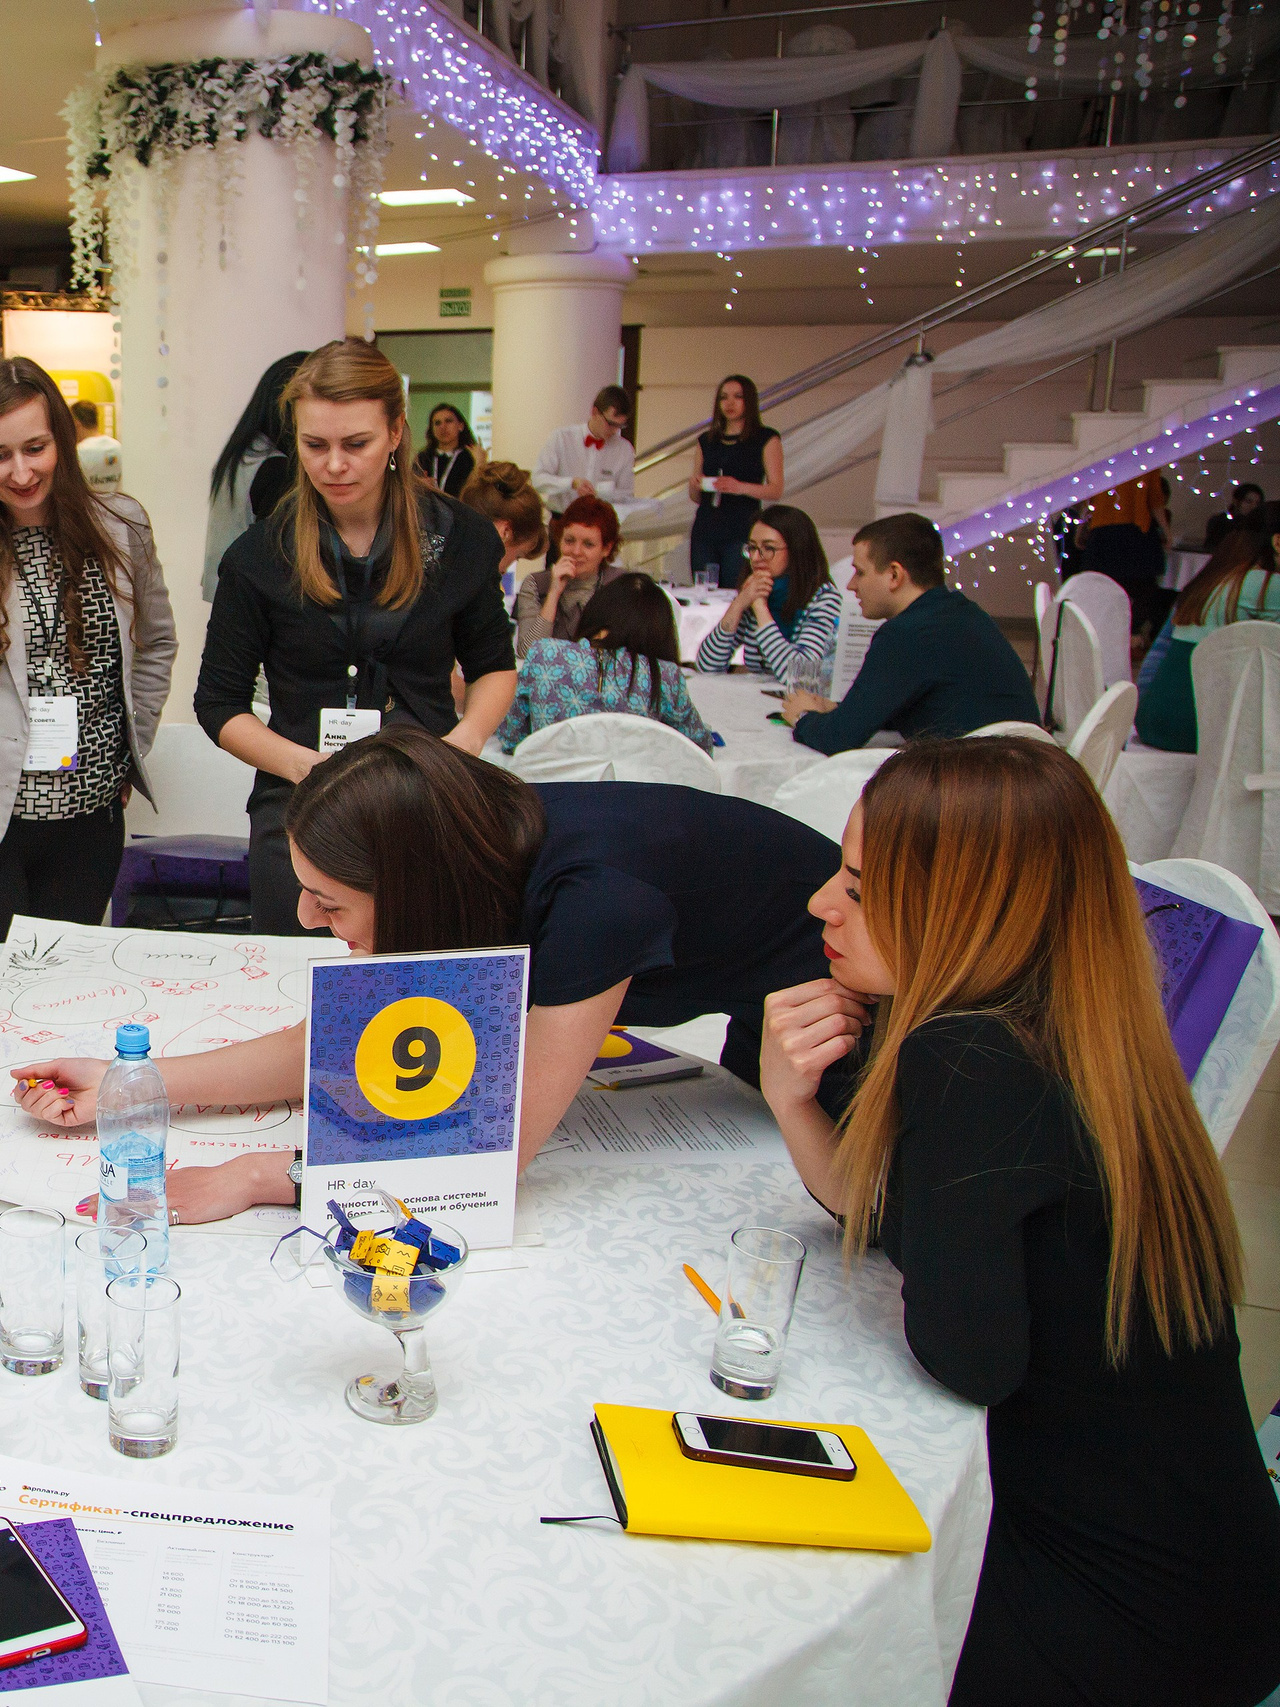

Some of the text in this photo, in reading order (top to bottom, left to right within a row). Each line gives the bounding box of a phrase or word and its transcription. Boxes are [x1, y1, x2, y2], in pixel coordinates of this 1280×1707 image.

[392, 1026, 440, 1092] 9
[329, 1200, 379, 1209] енности
[403, 1195, 440, 1204] основа
[443, 1190, 487, 1202] системы
[449, 1200, 498, 1212] обучения
[19, 1494, 294, 1531] Сертификат-спецпредложение
